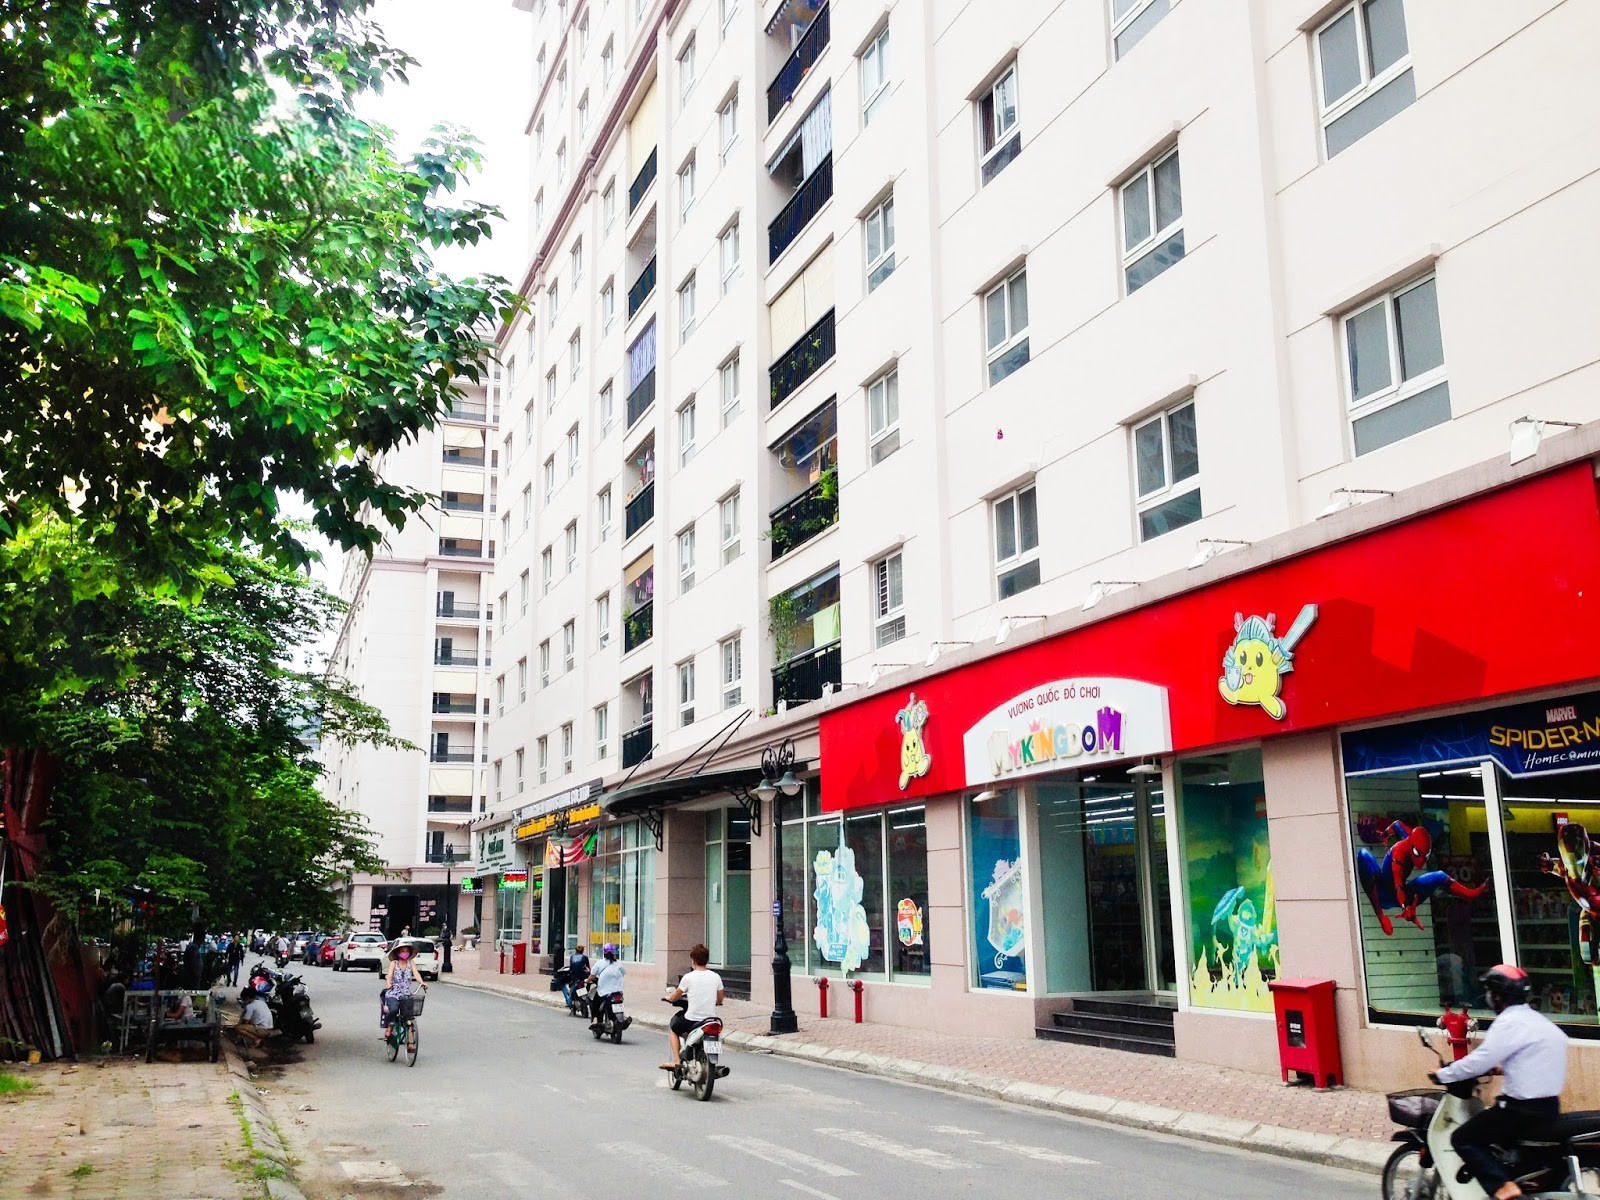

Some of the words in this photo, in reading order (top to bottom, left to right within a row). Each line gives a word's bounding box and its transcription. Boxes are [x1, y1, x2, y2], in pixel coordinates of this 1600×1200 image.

[1036, 686, 1060, 706] QUỐC
[1080, 685, 1101, 699] CHƠI
[1546, 705, 1577, 723] MARVEL
[987, 706, 1125, 776] MYKINGDOM
[1489, 715, 1600, 750] SPIDER-M
